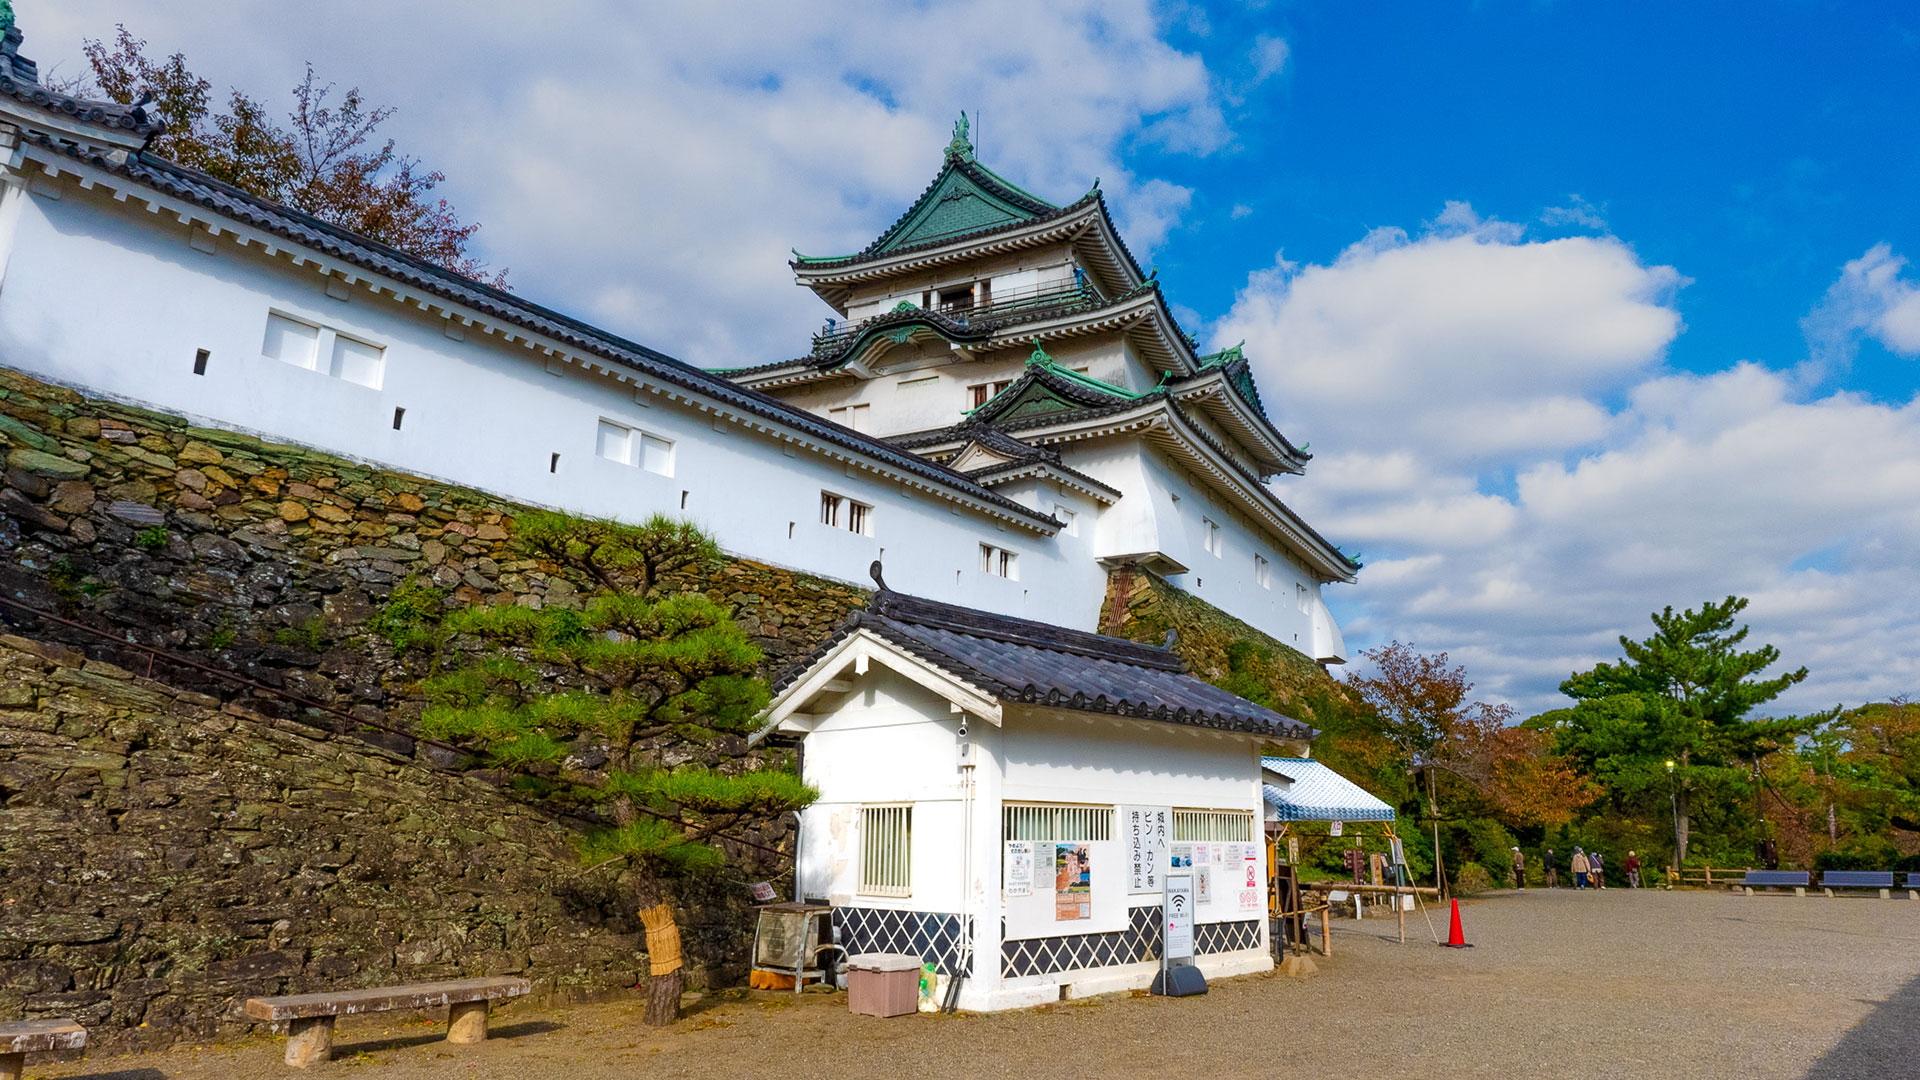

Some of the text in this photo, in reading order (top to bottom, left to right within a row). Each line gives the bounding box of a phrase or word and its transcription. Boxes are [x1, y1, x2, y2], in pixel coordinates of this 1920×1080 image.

[1131, 810, 1142, 889] 持ち込み禁止
[1144, 811, 1155, 888] ビン・カン等
[1157, 811, 1166, 849] 城内へ
